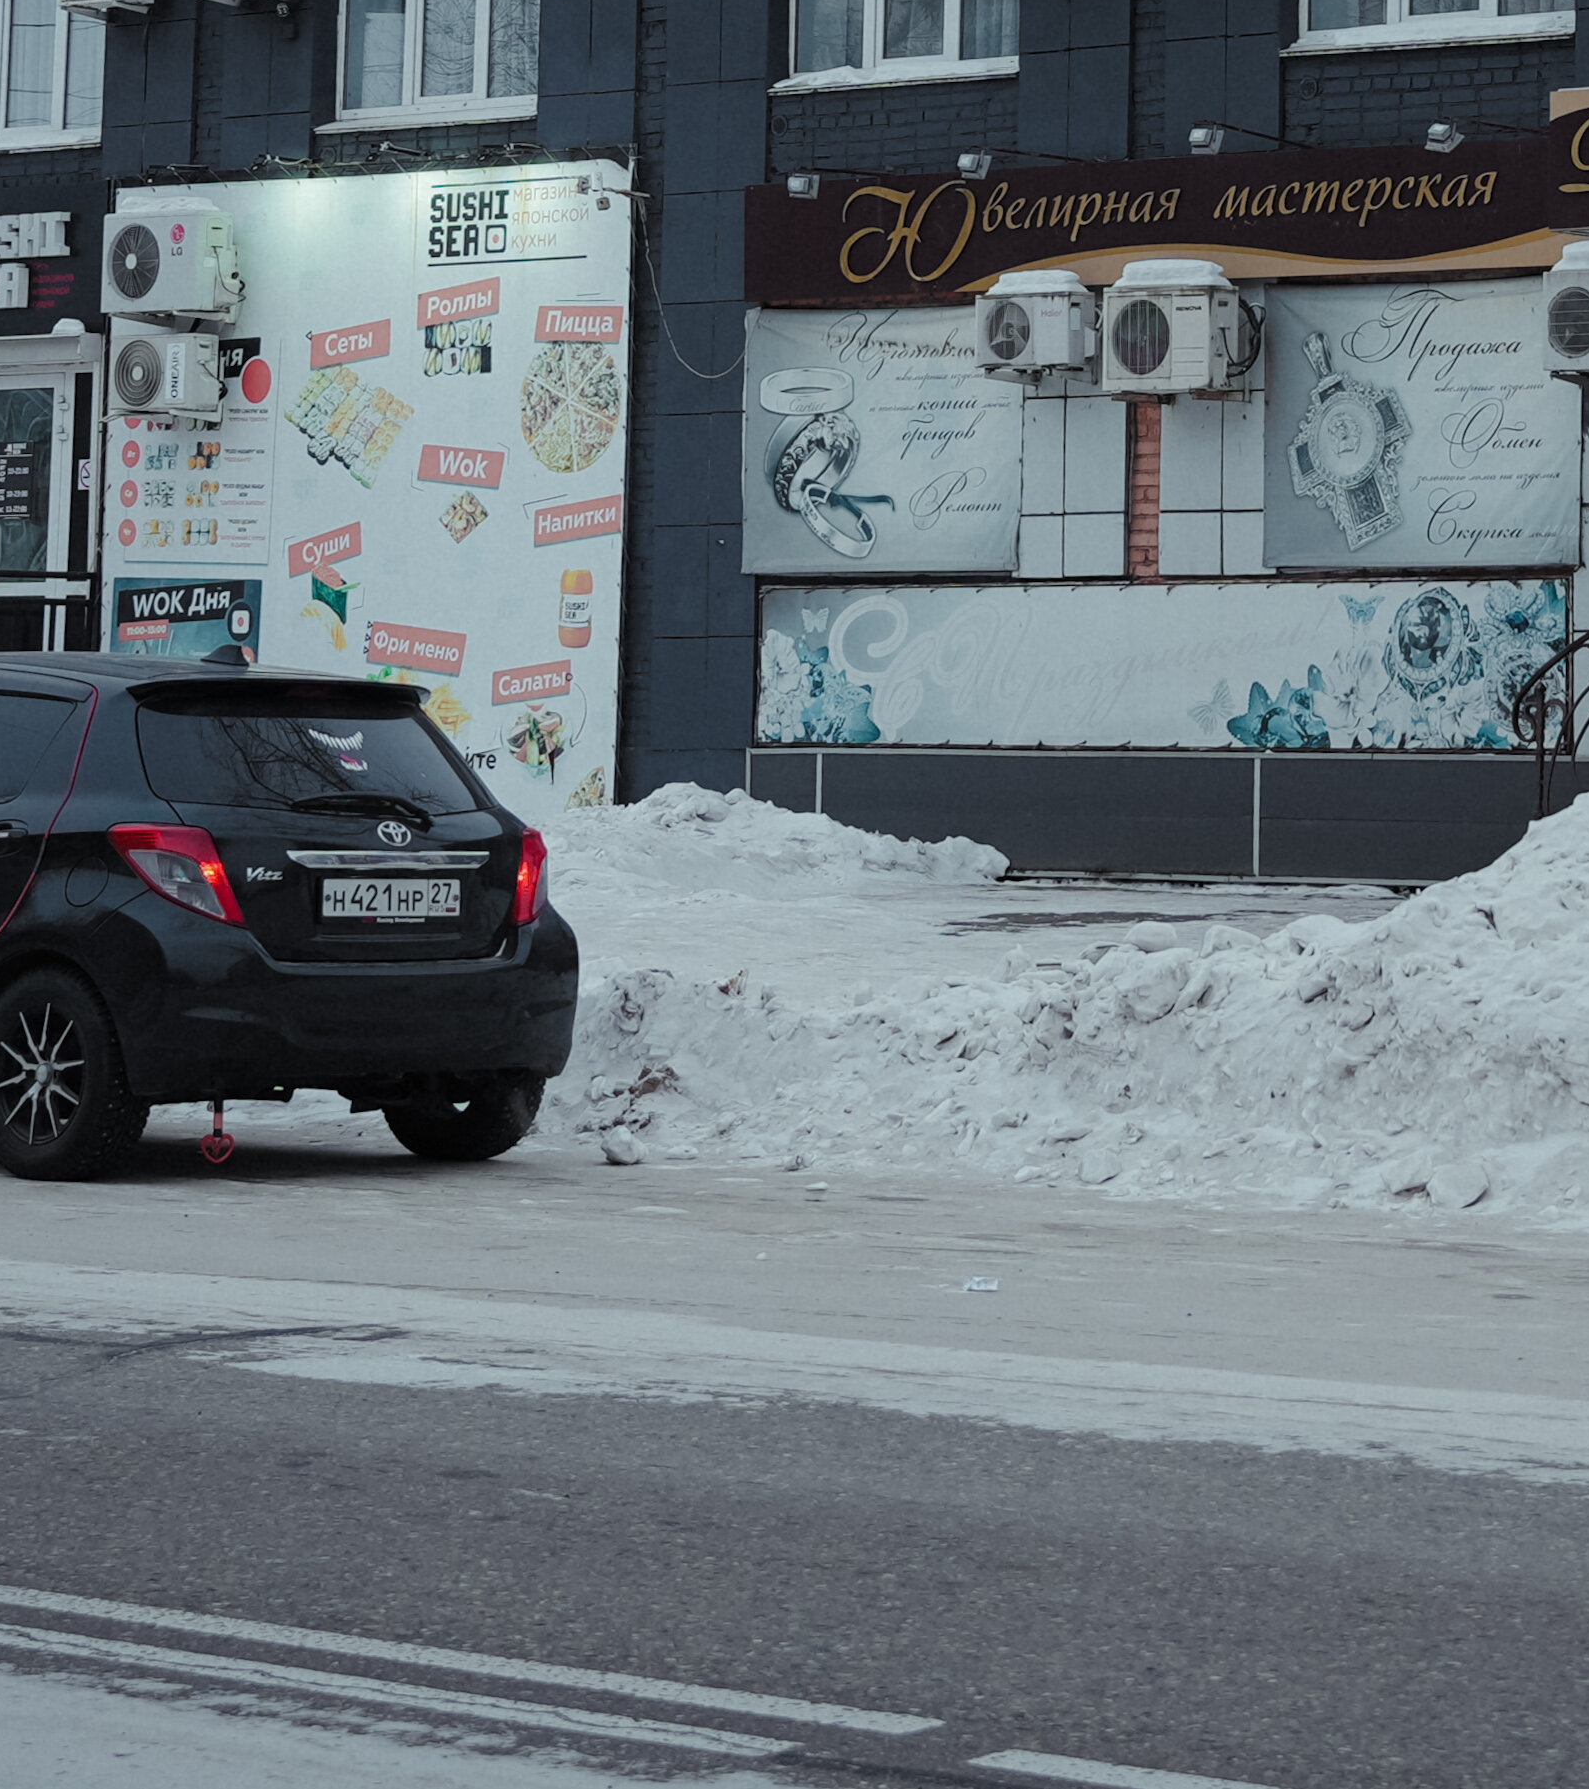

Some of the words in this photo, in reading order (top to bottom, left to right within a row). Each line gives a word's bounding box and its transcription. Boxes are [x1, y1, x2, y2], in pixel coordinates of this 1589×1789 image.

[429, 189, 510, 223] SUSHI
[511, 203, 590, 226] японской
[427, 224, 480, 258] SEA
[839, 179, 1182, 284] Ювелирная
[1213, 170, 1498, 228] мастерская
[171, 246, 183, 257] LG
[510, 233, 558, 254] кухни
[426, 287, 493, 319] Роллы
[544, 309, 615, 338] Пицца
[1340, 287, 1524, 382] Продажа
[323, 329, 374, 357] Сеты
[915, 395, 979, 411] копий
[1440, 397, 1544, 469] Обмен
[438, 449, 489, 479] Wok
[909, 466, 1003, 531] Ремонт
[536, 505, 617, 536] Напитки
[1427, 487, 1524, 558] Скупка
[301, 531, 351, 566] Суши
[132, 588, 186, 619] WOK
[187, 586, 231, 617] Дня
[372, 629, 411, 656] Фри
[413, 641, 461, 664] меню
[497, 669, 568, 696] Салаты
[245, 866, 284, 883] Vitz
[332, 883, 425, 913] Н421НР
[430, 882, 453, 904] 27
